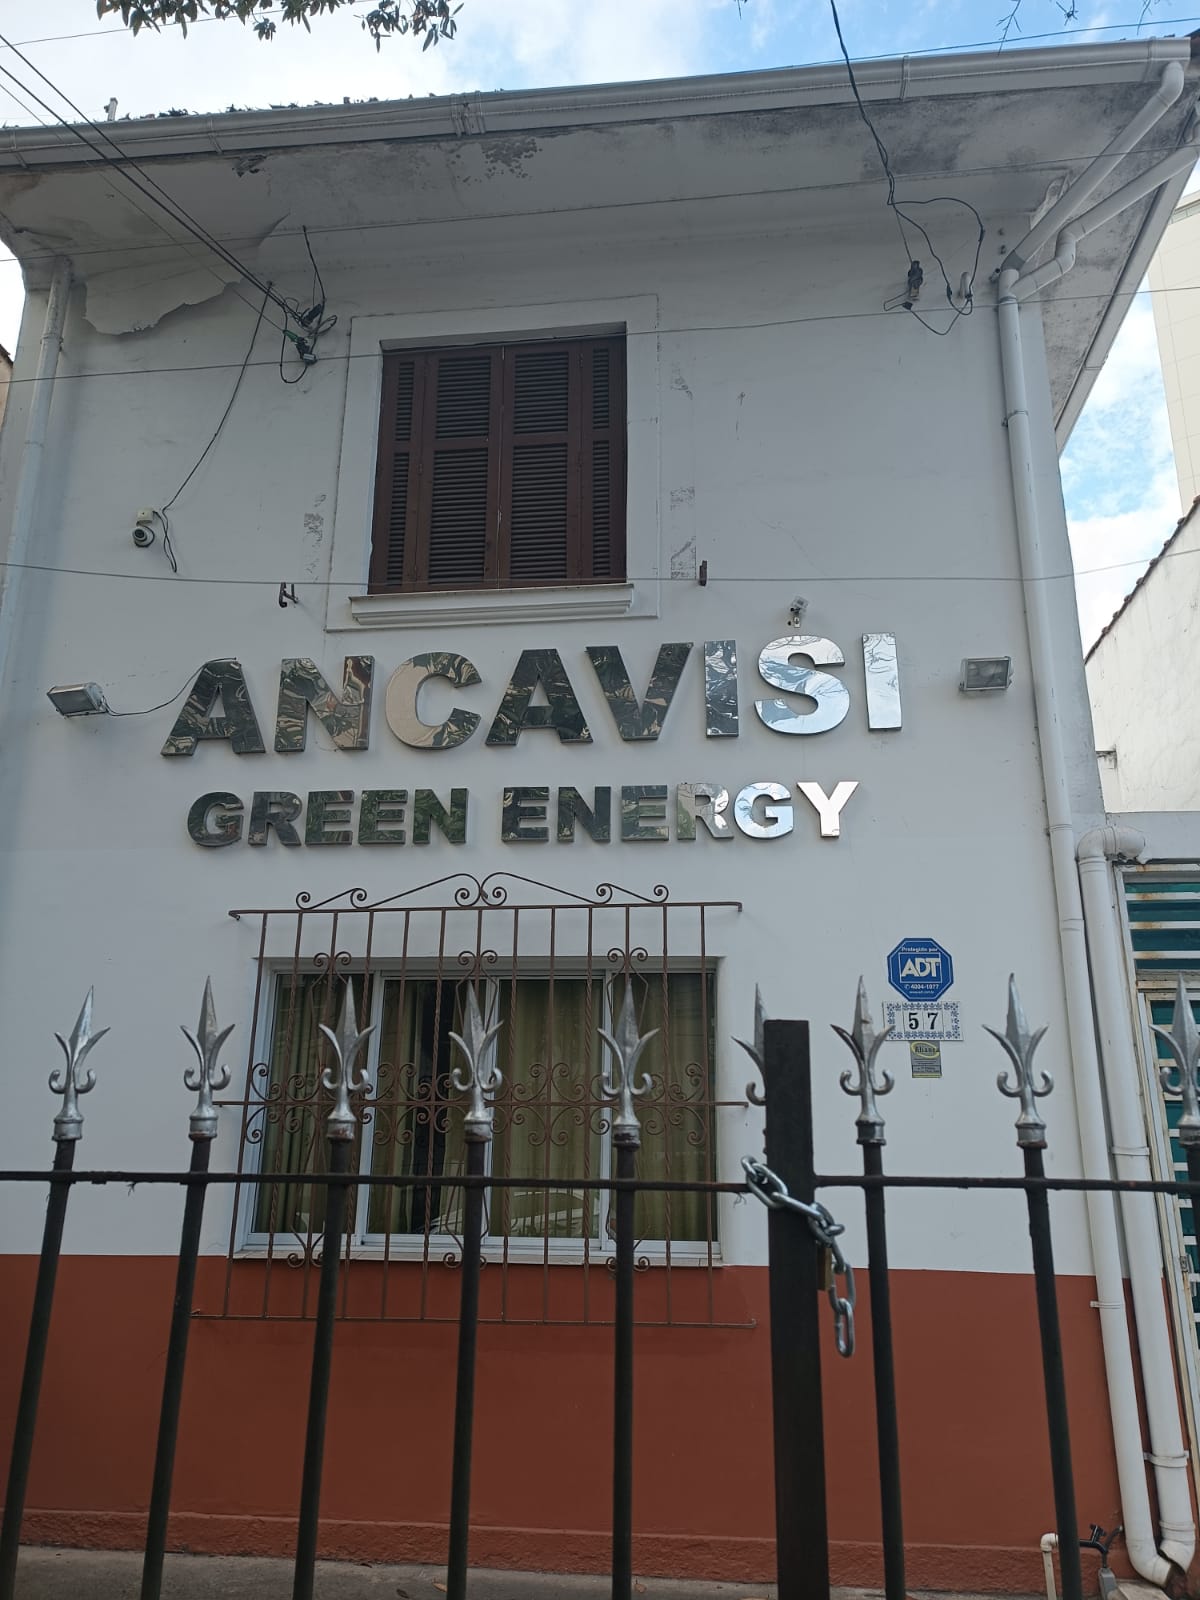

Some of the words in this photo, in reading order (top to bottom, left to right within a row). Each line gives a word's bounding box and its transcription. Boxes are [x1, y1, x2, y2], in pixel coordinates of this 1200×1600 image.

[161, 633, 902, 756] ANCAVISI
[187, 788, 470, 847] GREEN
[501, 781, 860, 842] ENERGY
[901, 957, 941, 977] ADT
[908, 1012, 939, 1030] 57
